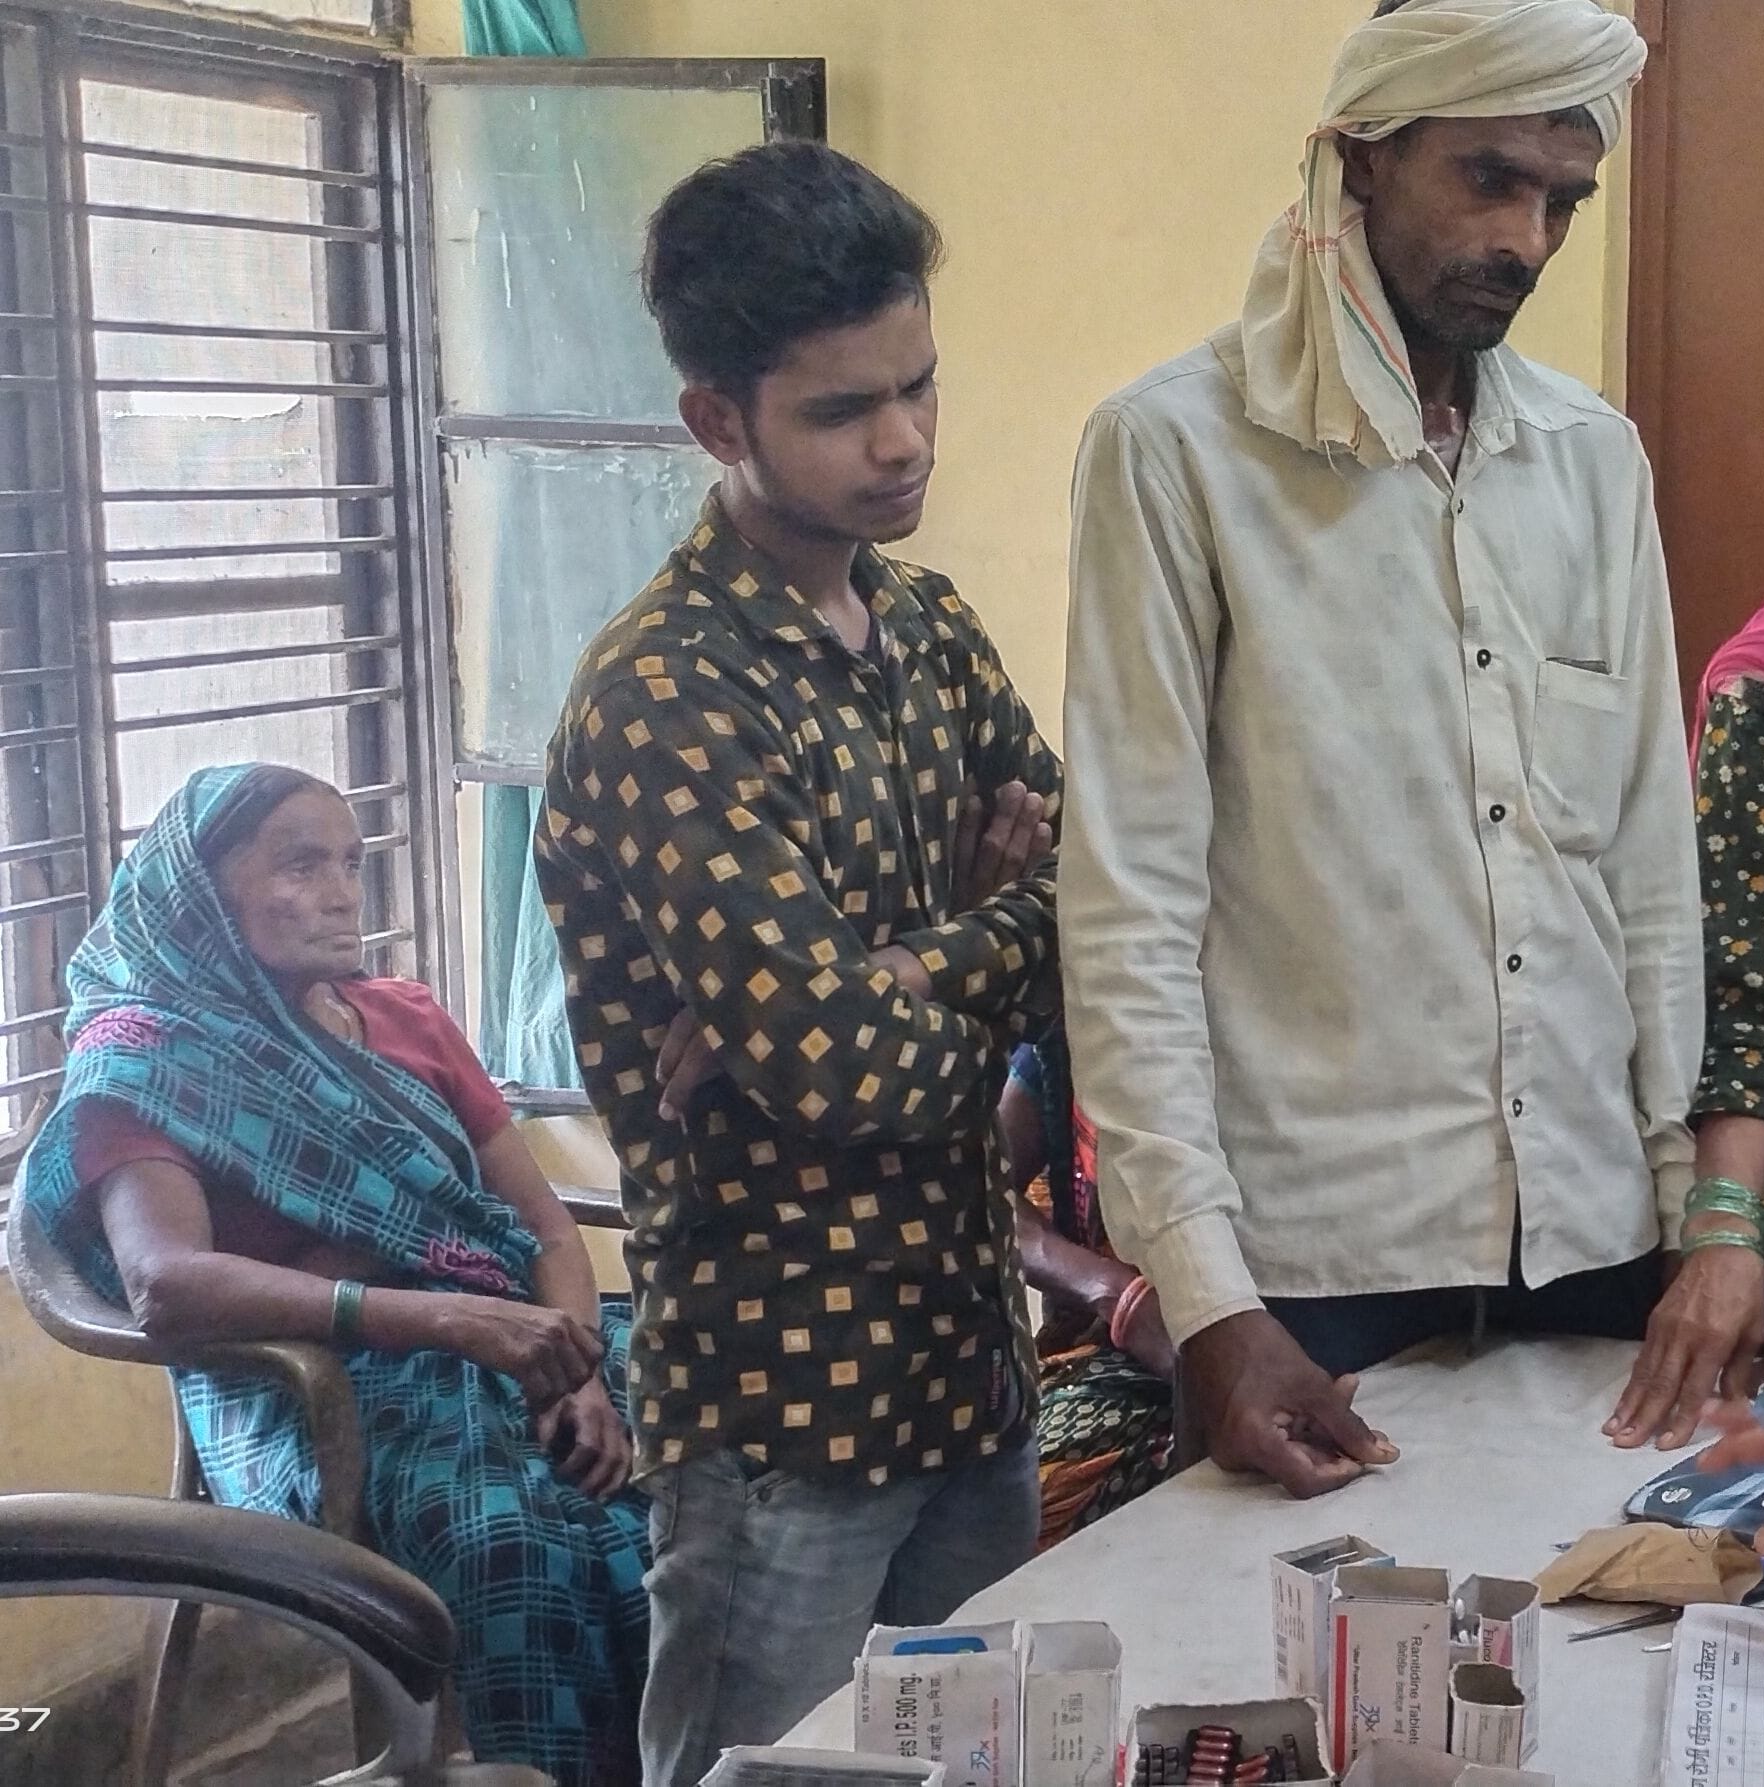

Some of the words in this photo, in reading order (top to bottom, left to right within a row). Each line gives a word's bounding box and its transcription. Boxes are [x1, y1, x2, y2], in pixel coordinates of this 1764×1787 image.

[862, 1662, 871, 1689] Tablets
[1408, 1636, 1423, 1700] Ranitidine
[900, 1673, 922, 1695] mg.
[895, 1697, 917, 1719] 500
